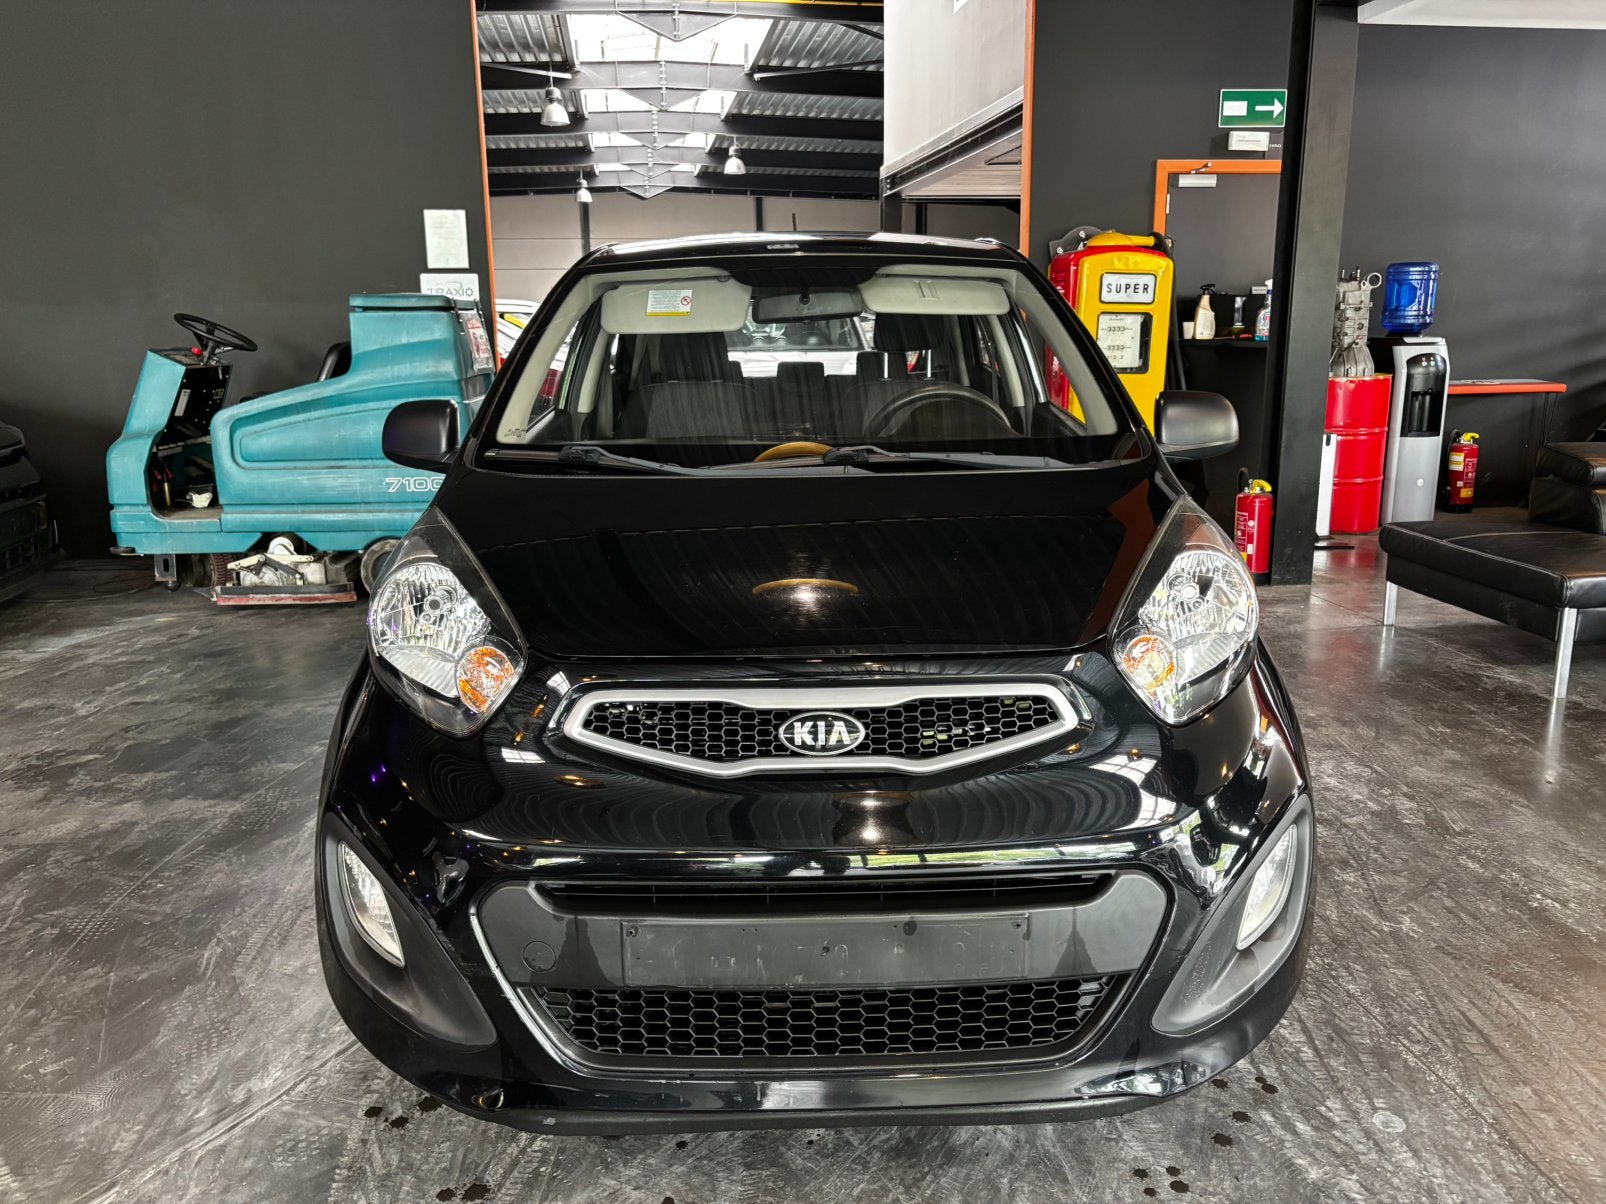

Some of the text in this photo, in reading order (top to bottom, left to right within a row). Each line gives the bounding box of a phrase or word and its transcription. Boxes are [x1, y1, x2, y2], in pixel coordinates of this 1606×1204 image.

[426, 287, 474, 297] TRAXIO
[1106, 283, 1149, 294] SUPER
[385, 476, 445, 493] 7100
[793, 721, 851, 746] KIA
